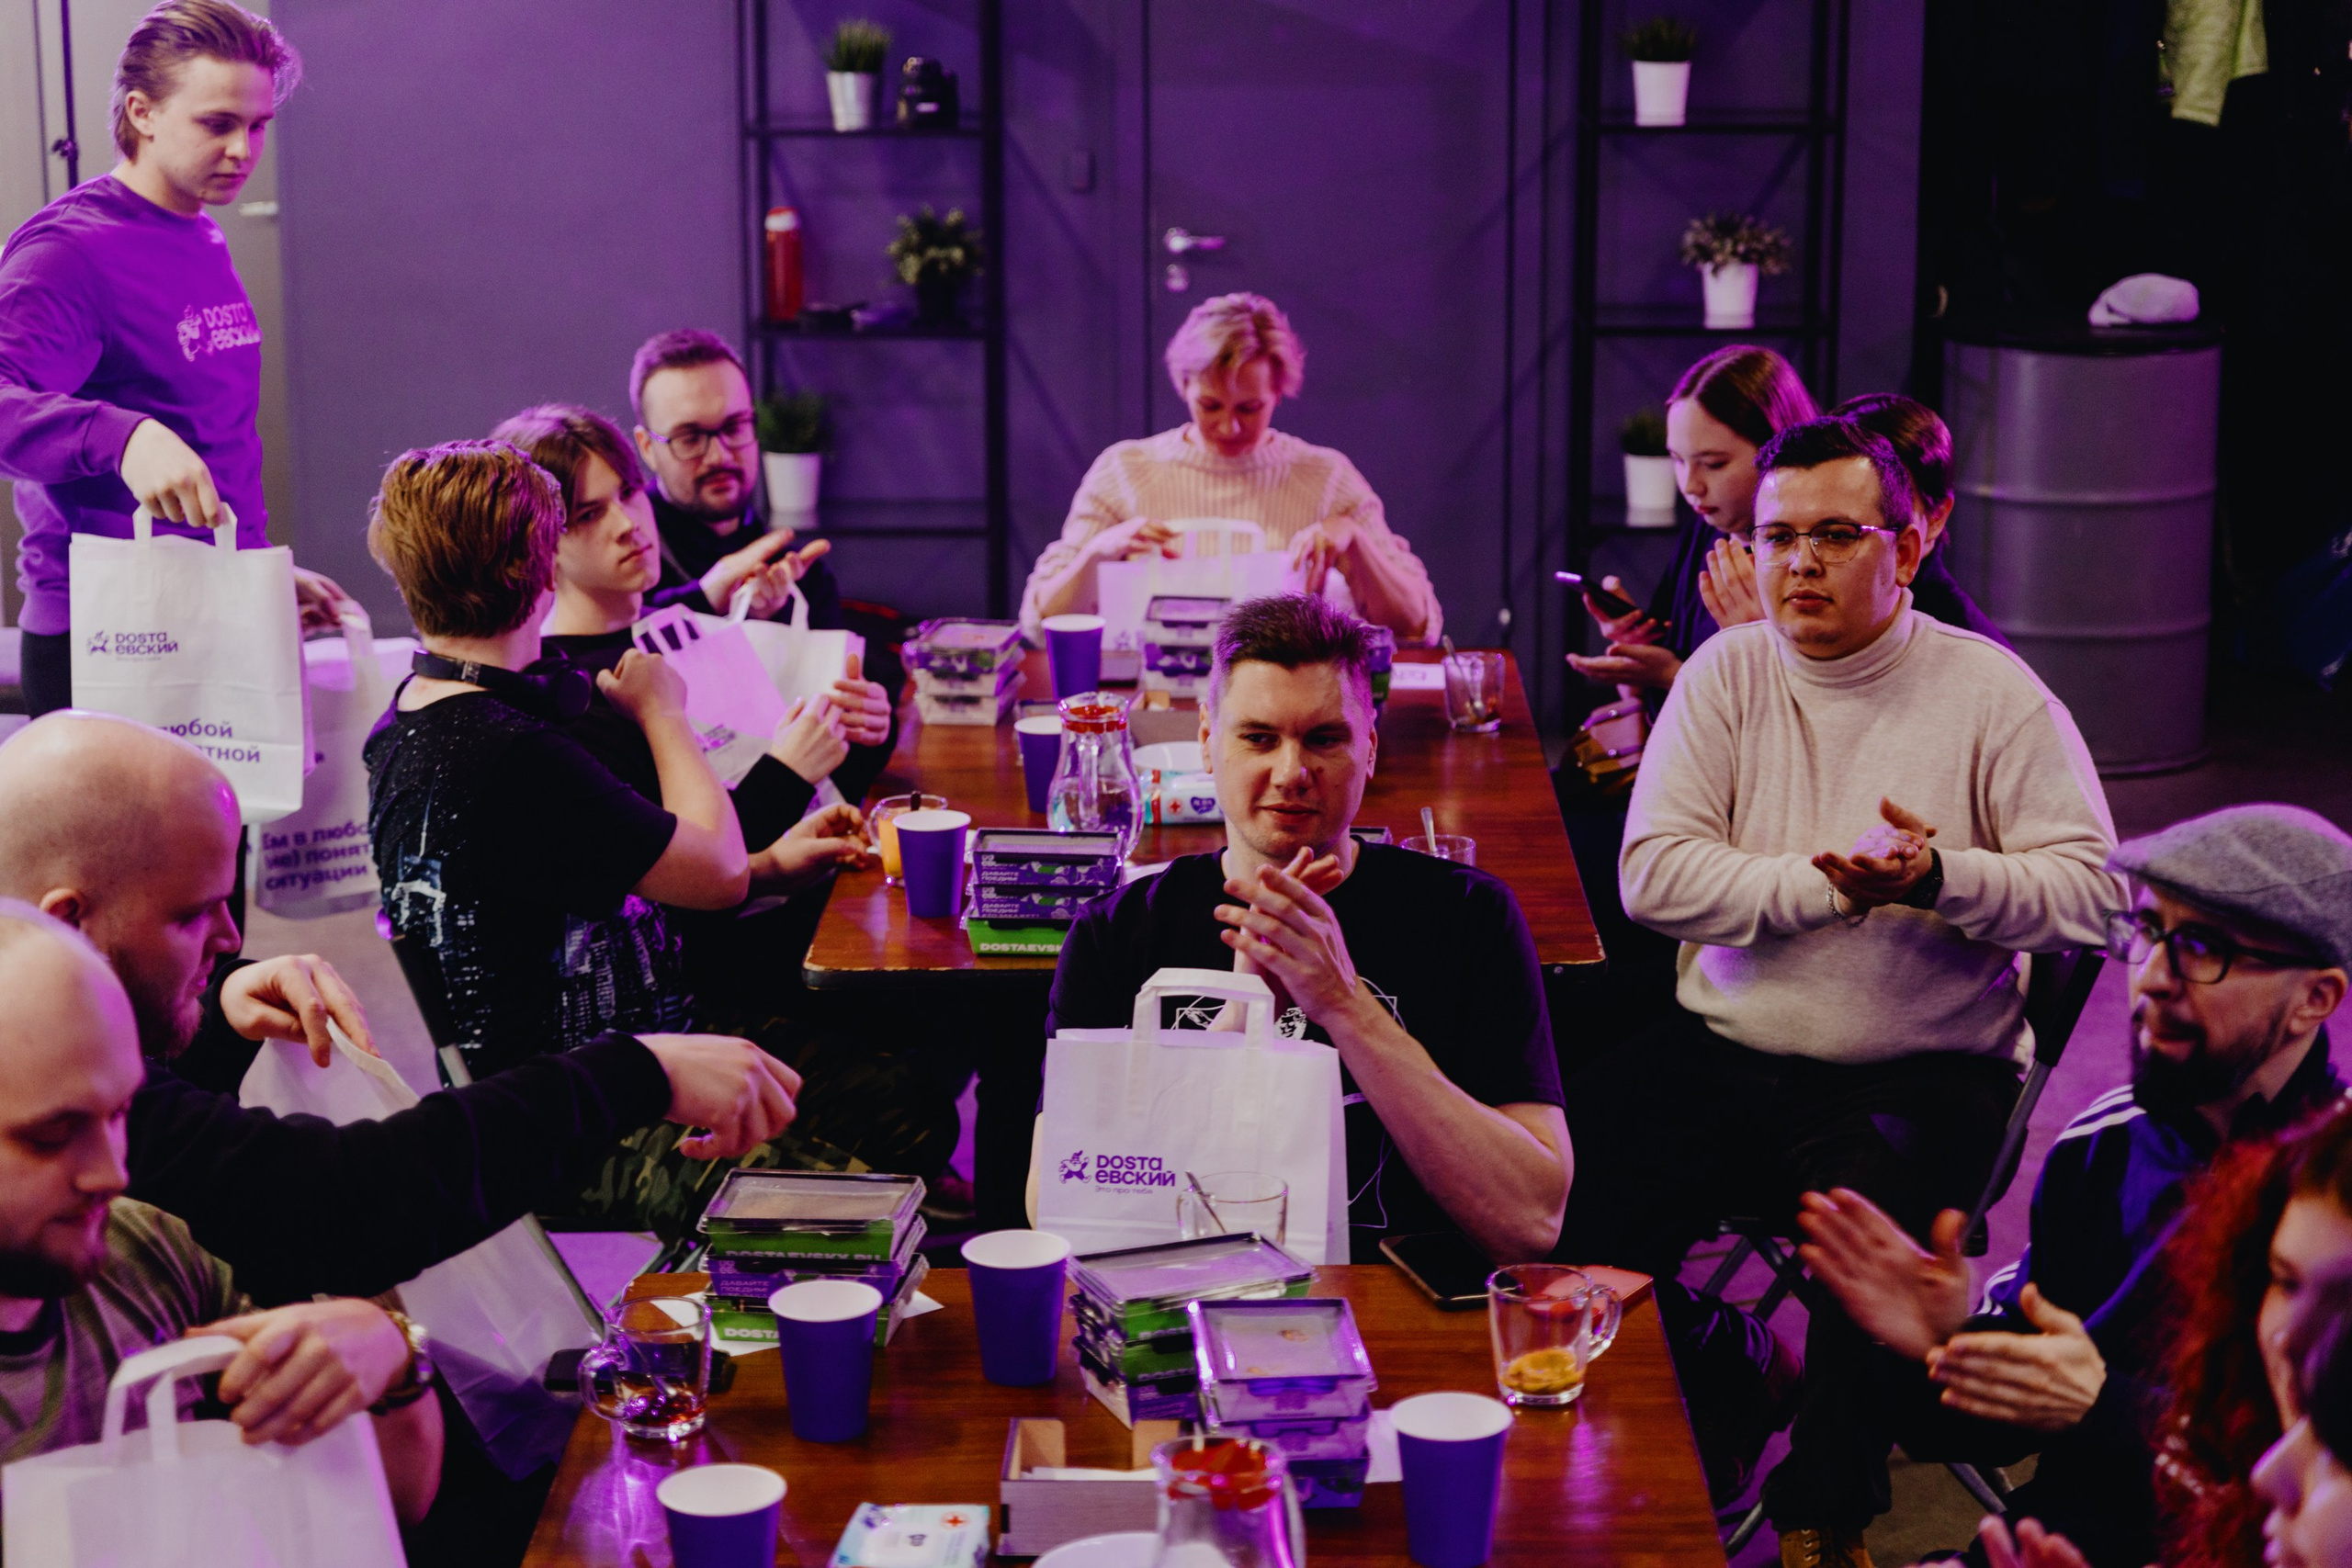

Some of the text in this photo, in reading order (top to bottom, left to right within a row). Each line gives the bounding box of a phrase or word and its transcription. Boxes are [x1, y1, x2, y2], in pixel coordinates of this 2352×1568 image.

[159, 718, 233, 738] юбой
[196, 745, 261, 763] тной
[313, 821, 368, 843] любо
[305, 843, 369, 863] понят
[265, 865, 367, 890] ситуации
[1094, 1169, 1176, 1187] евский
[724, 1327, 780, 1339] DOSTA
